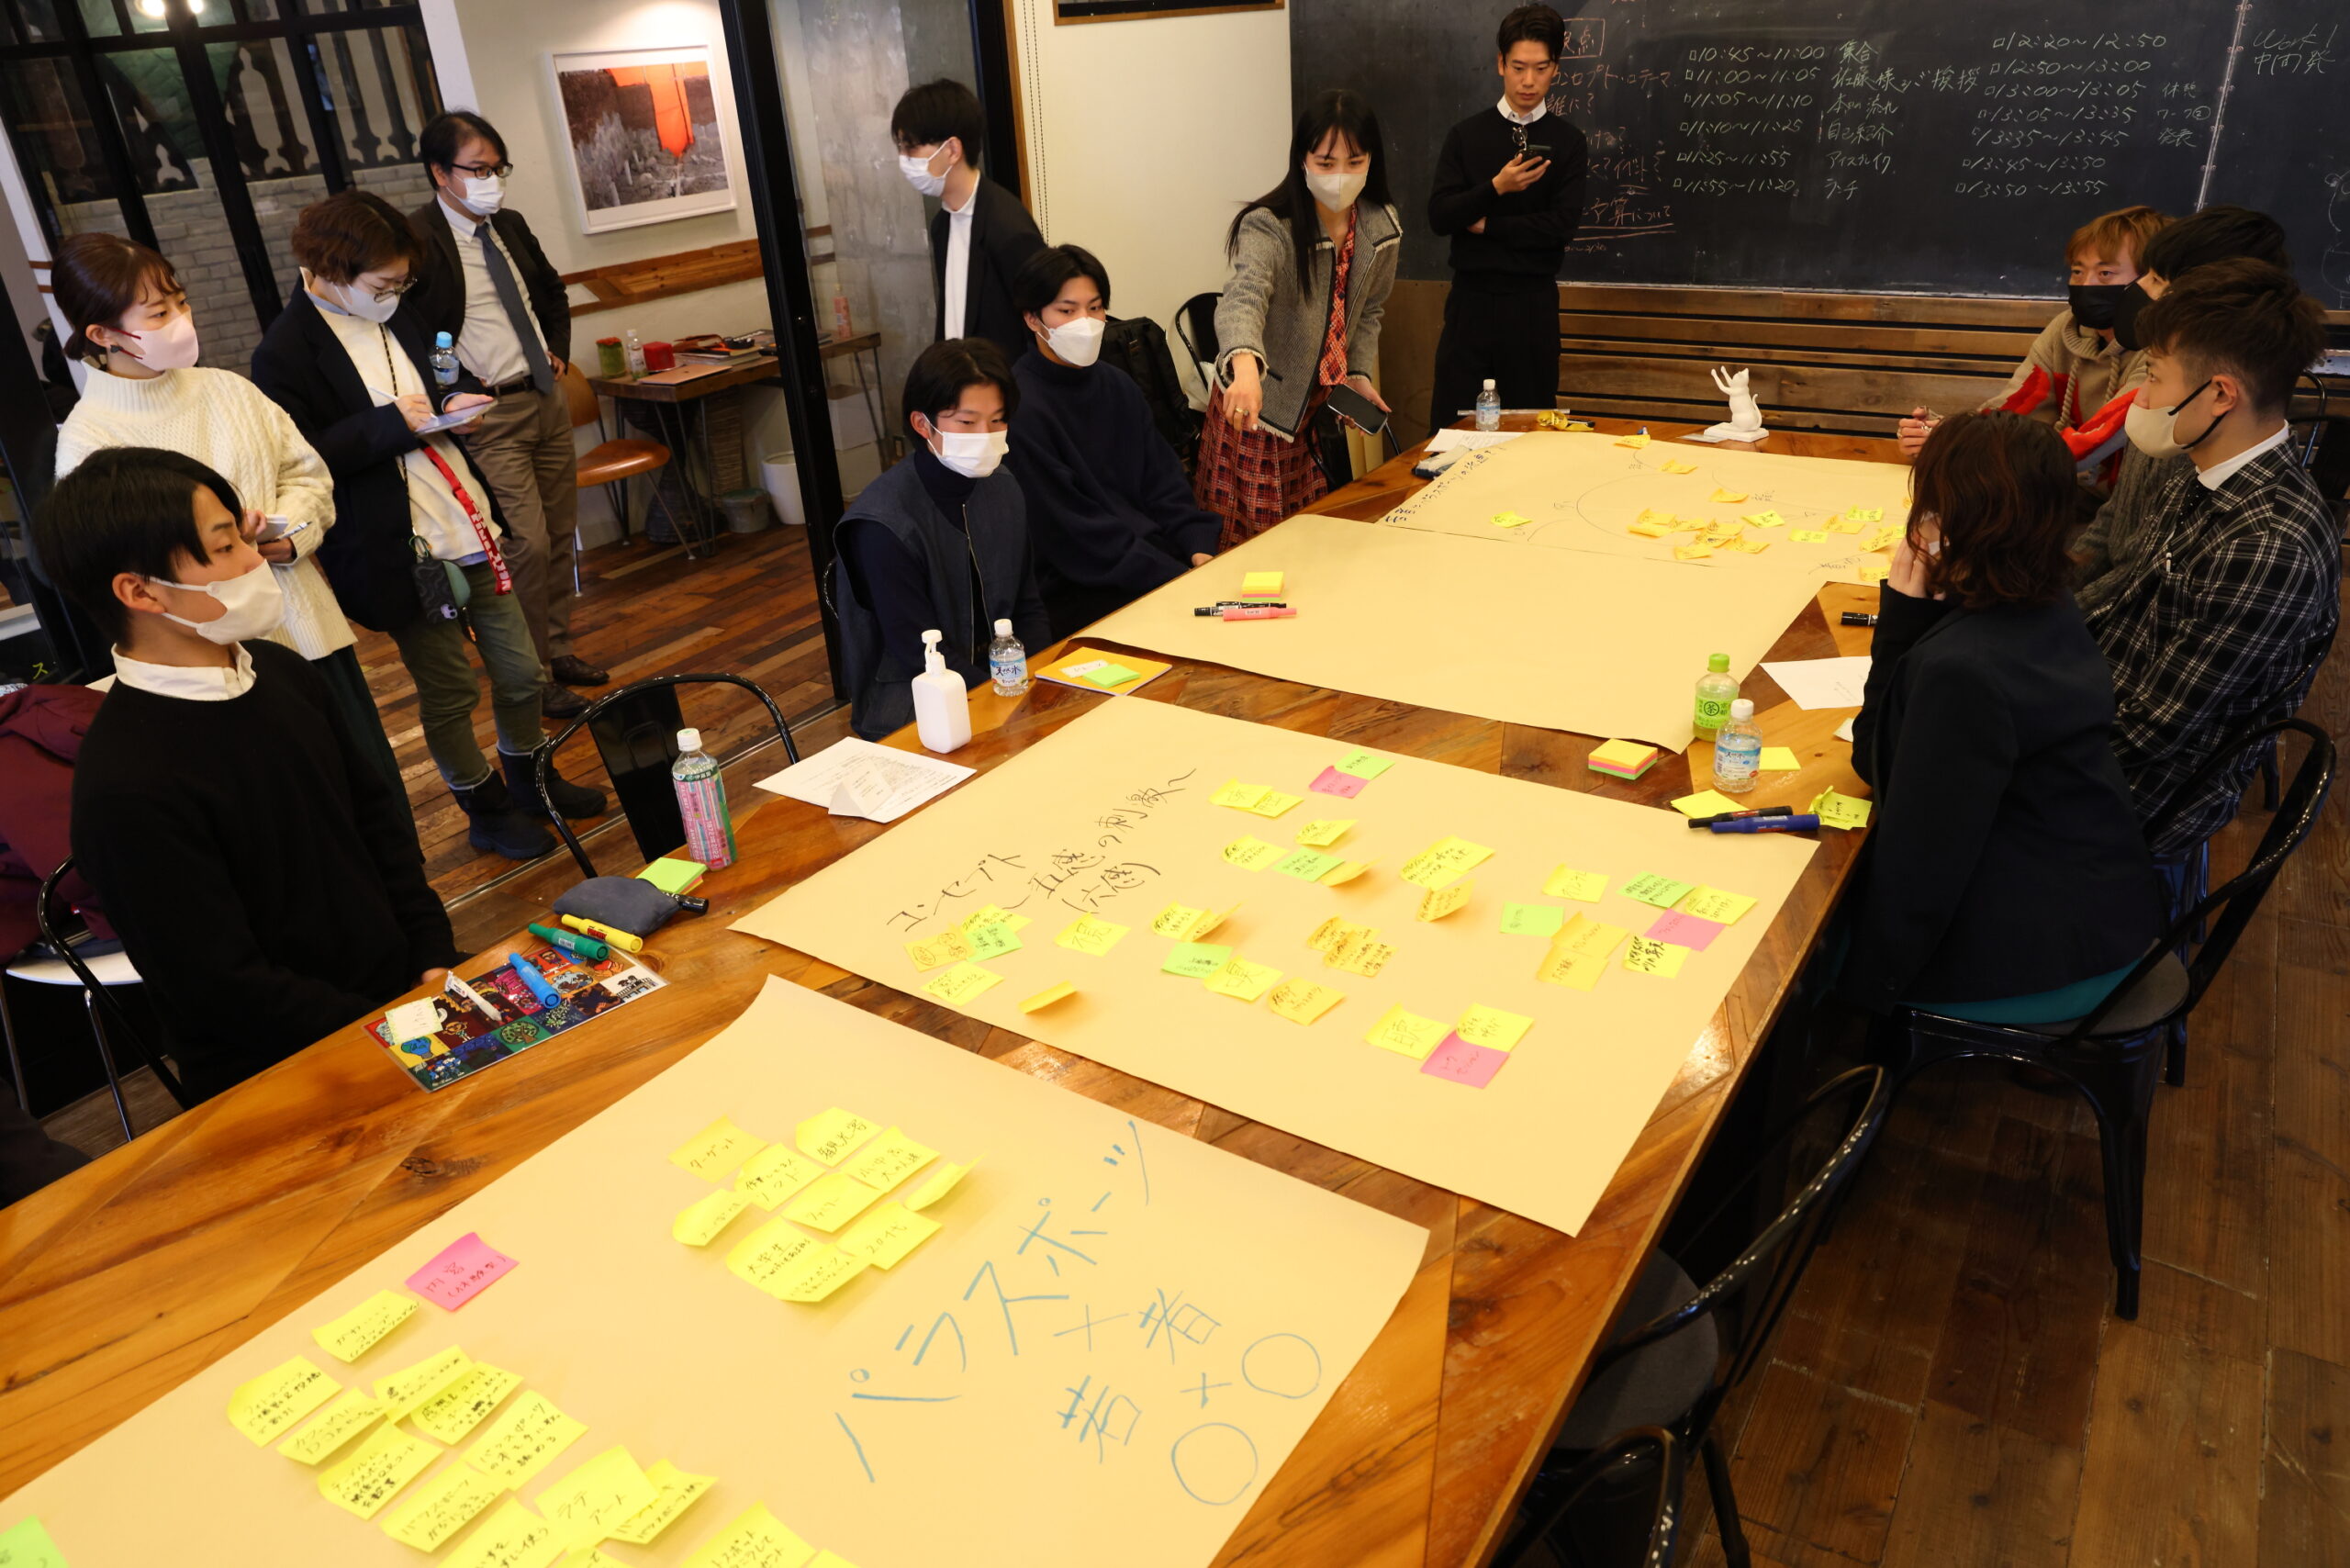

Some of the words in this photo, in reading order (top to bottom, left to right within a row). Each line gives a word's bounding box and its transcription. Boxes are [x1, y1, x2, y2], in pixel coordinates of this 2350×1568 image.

[1839, 39, 1879, 64] 集合
[1828, 119, 1894, 147] 自己紹介
[688, 1137, 733, 1169] ターゲット
[816, 1118, 867, 1159] 観光客
[746, 1242, 783, 1274] 大学生
[834, 1121, 1147, 1484] パラスポーツ
[556, 1490, 587, 1519] ラテ
[588, 1493, 623, 1526] アート
